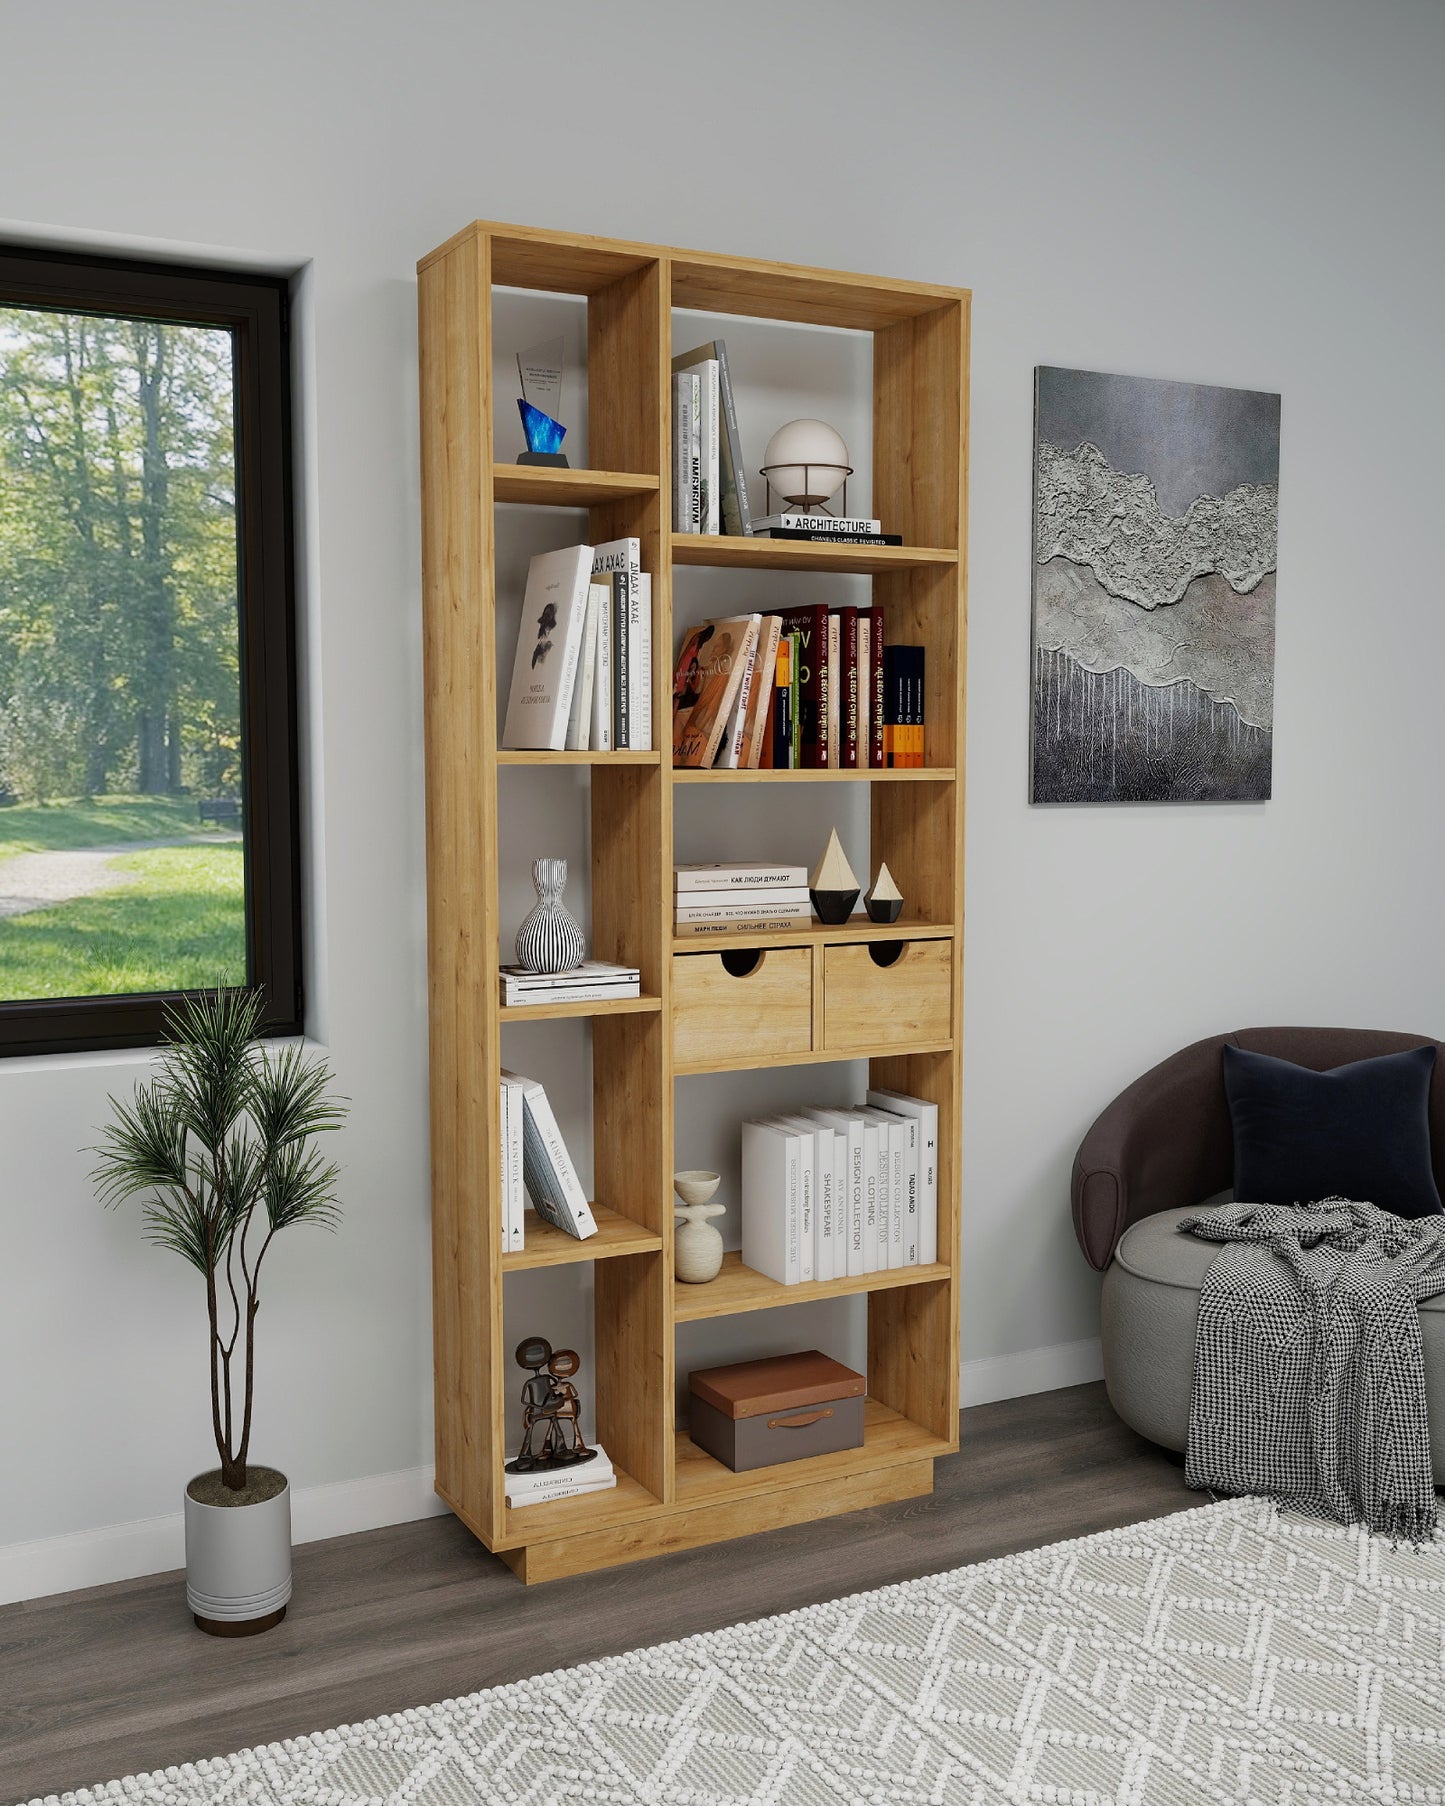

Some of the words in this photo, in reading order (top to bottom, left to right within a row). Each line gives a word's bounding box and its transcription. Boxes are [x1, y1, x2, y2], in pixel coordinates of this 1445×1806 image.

[795, 517, 872, 533] ARCHITECTURE
[744, 876, 763, 884] ЛЮДИ
[763, 875, 790, 883] ДУМАЮТ
[737, 923, 766, 931] СИЛЬНЕЕ
[769, 921, 791, 929] СТРАХА
[549, 1139, 569, 1178] KINFOLK
[853, 1147, 862, 1184] DESIGN
[879, 1150, 888, 1185] DESIGN
[867, 1175, 875, 1226] CLOTHING
[908, 1173, 916, 1196] TADAO
[823, 1173, 831, 1239] SHAKESPEARE
[853, 1184, 862, 1251] COLLECTION
[879, 1185, 888, 1243] COLLECTION
[908, 1195, 916, 1214] ANDO
